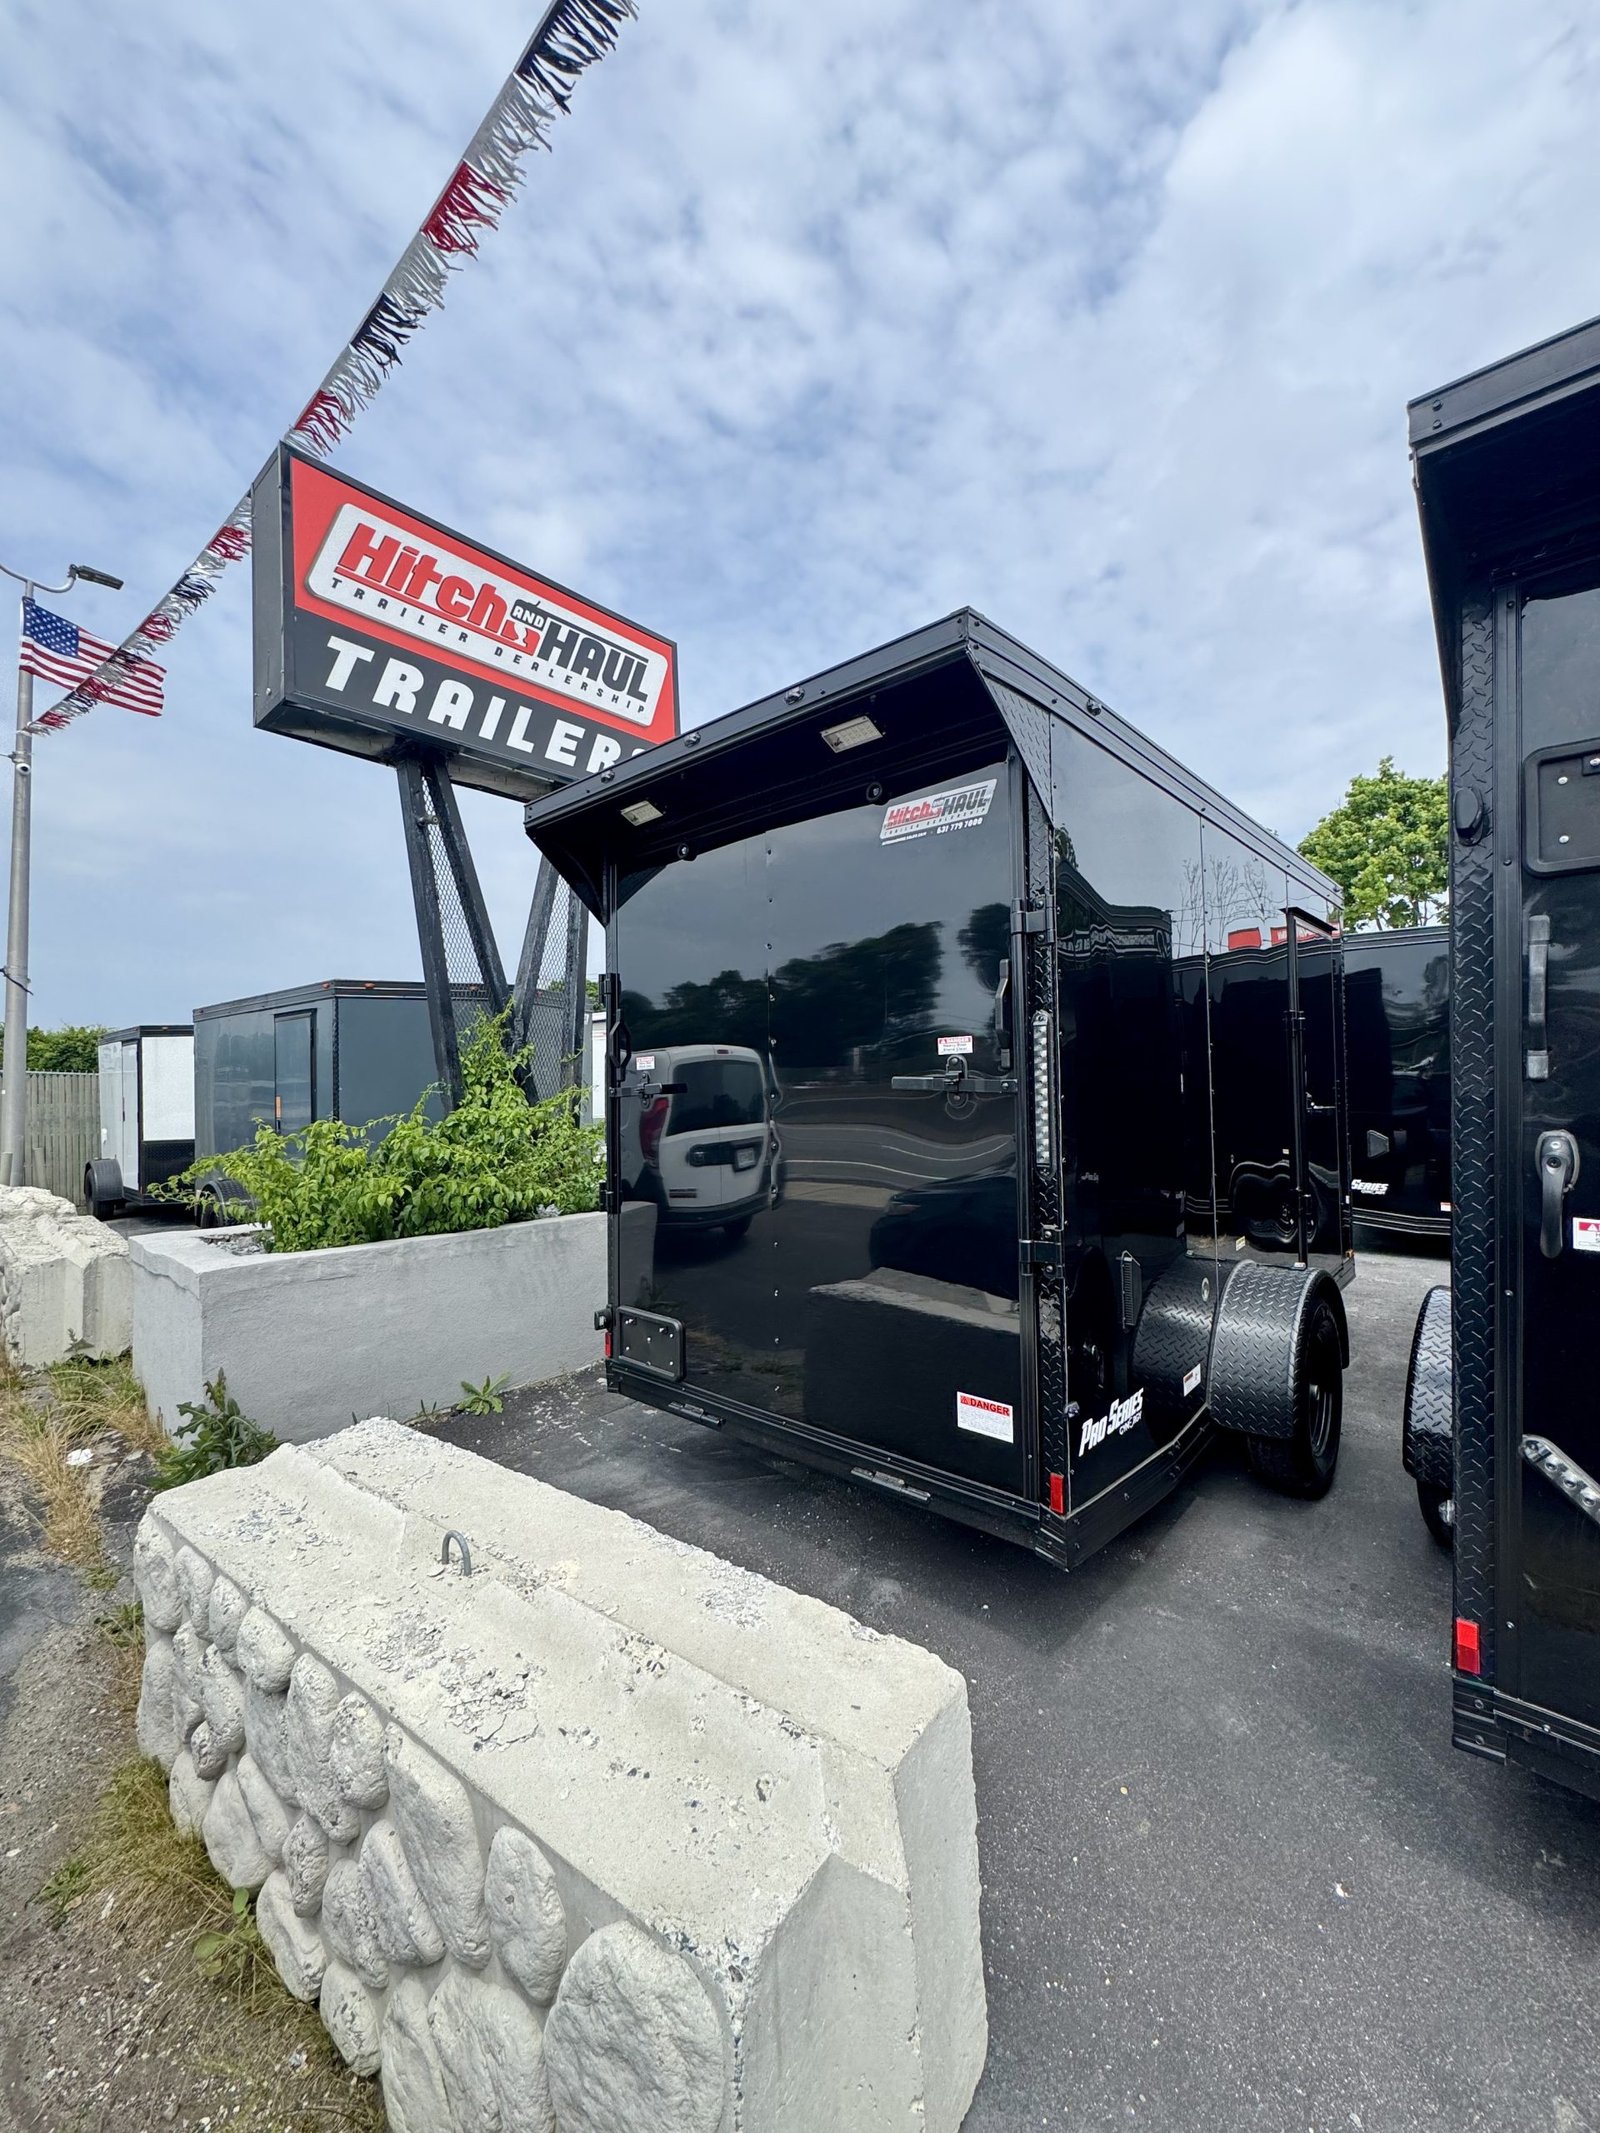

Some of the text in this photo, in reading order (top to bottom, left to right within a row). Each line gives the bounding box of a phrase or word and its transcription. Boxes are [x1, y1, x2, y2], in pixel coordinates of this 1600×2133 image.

[331, 577, 645, 714] TRAILER DEALERSHIP
[338, 522, 648, 703] Hitch AND HAUL
[325, 635, 646, 774] TRAILER
[886, 788, 989, 827] Hitch HAUL
[970, 1398, 1010, 1416] DANGER
[1106, 1387, 1144, 1435] SERIES
